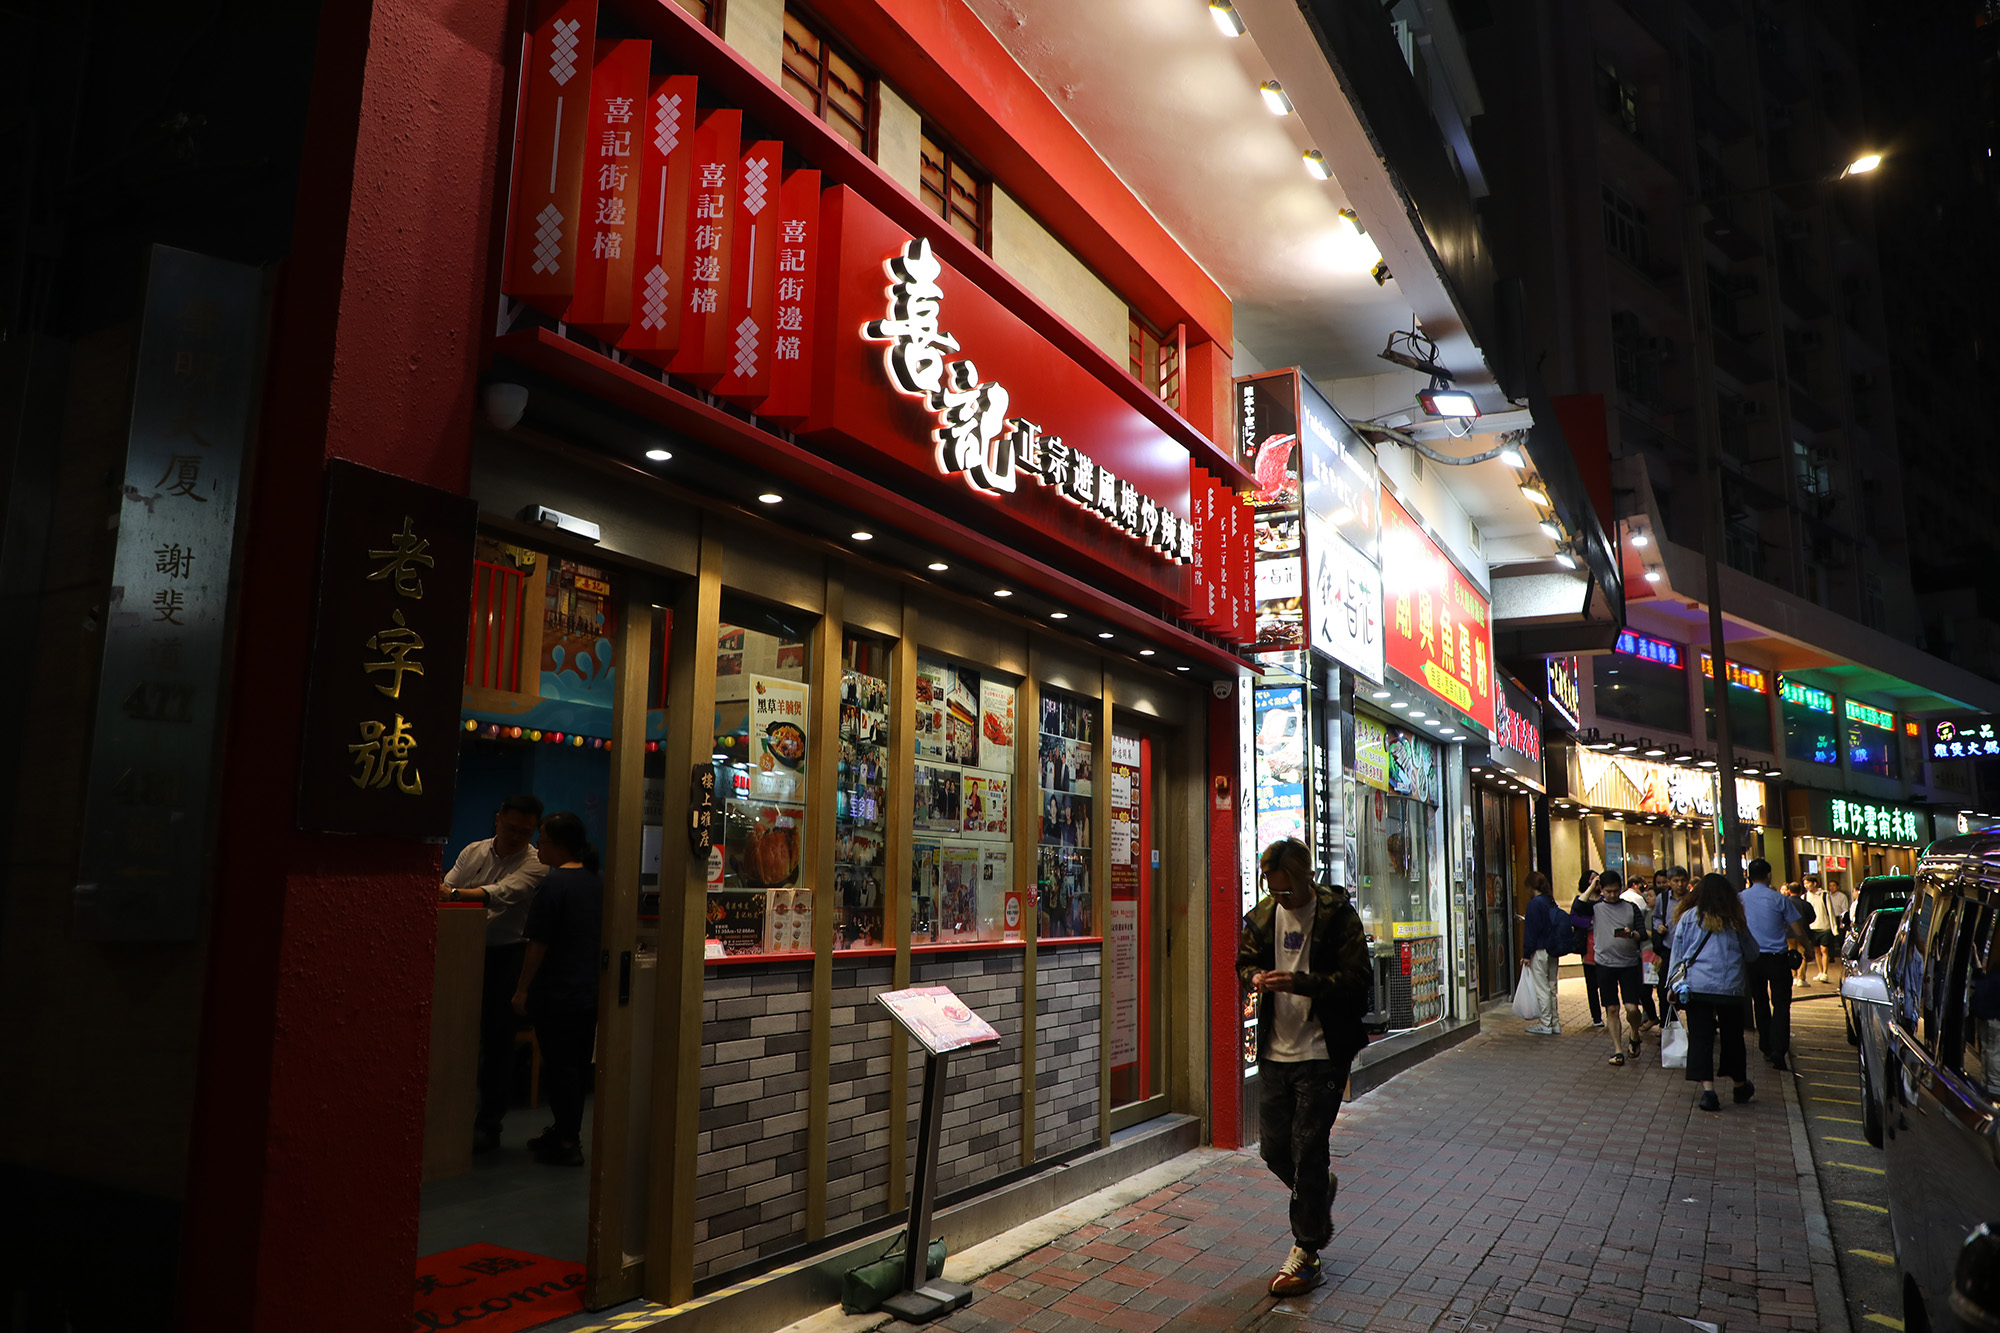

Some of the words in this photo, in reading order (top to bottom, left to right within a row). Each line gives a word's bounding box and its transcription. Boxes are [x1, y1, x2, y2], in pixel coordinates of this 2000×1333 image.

[592, 97, 634, 259] 喜記街邊檔
[690, 163, 726, 313] 喜記街邊檔
[774, 219, 807, 360] 喜記街邊檔
[860, 237, 1017, 496] 喜記
[1004, 417, 1194, 565] 正宗避風塘炒辣蟹
[349, 514, 434, 795] 老字號
[757, 698, 802, 716] 黑草羊腩煲
[1960, 724, 1994, 738] 一品
[700, 772, 714, 847] 樓上雅座
[1832, 799, 1918, 842] 譚仔雲南米線
